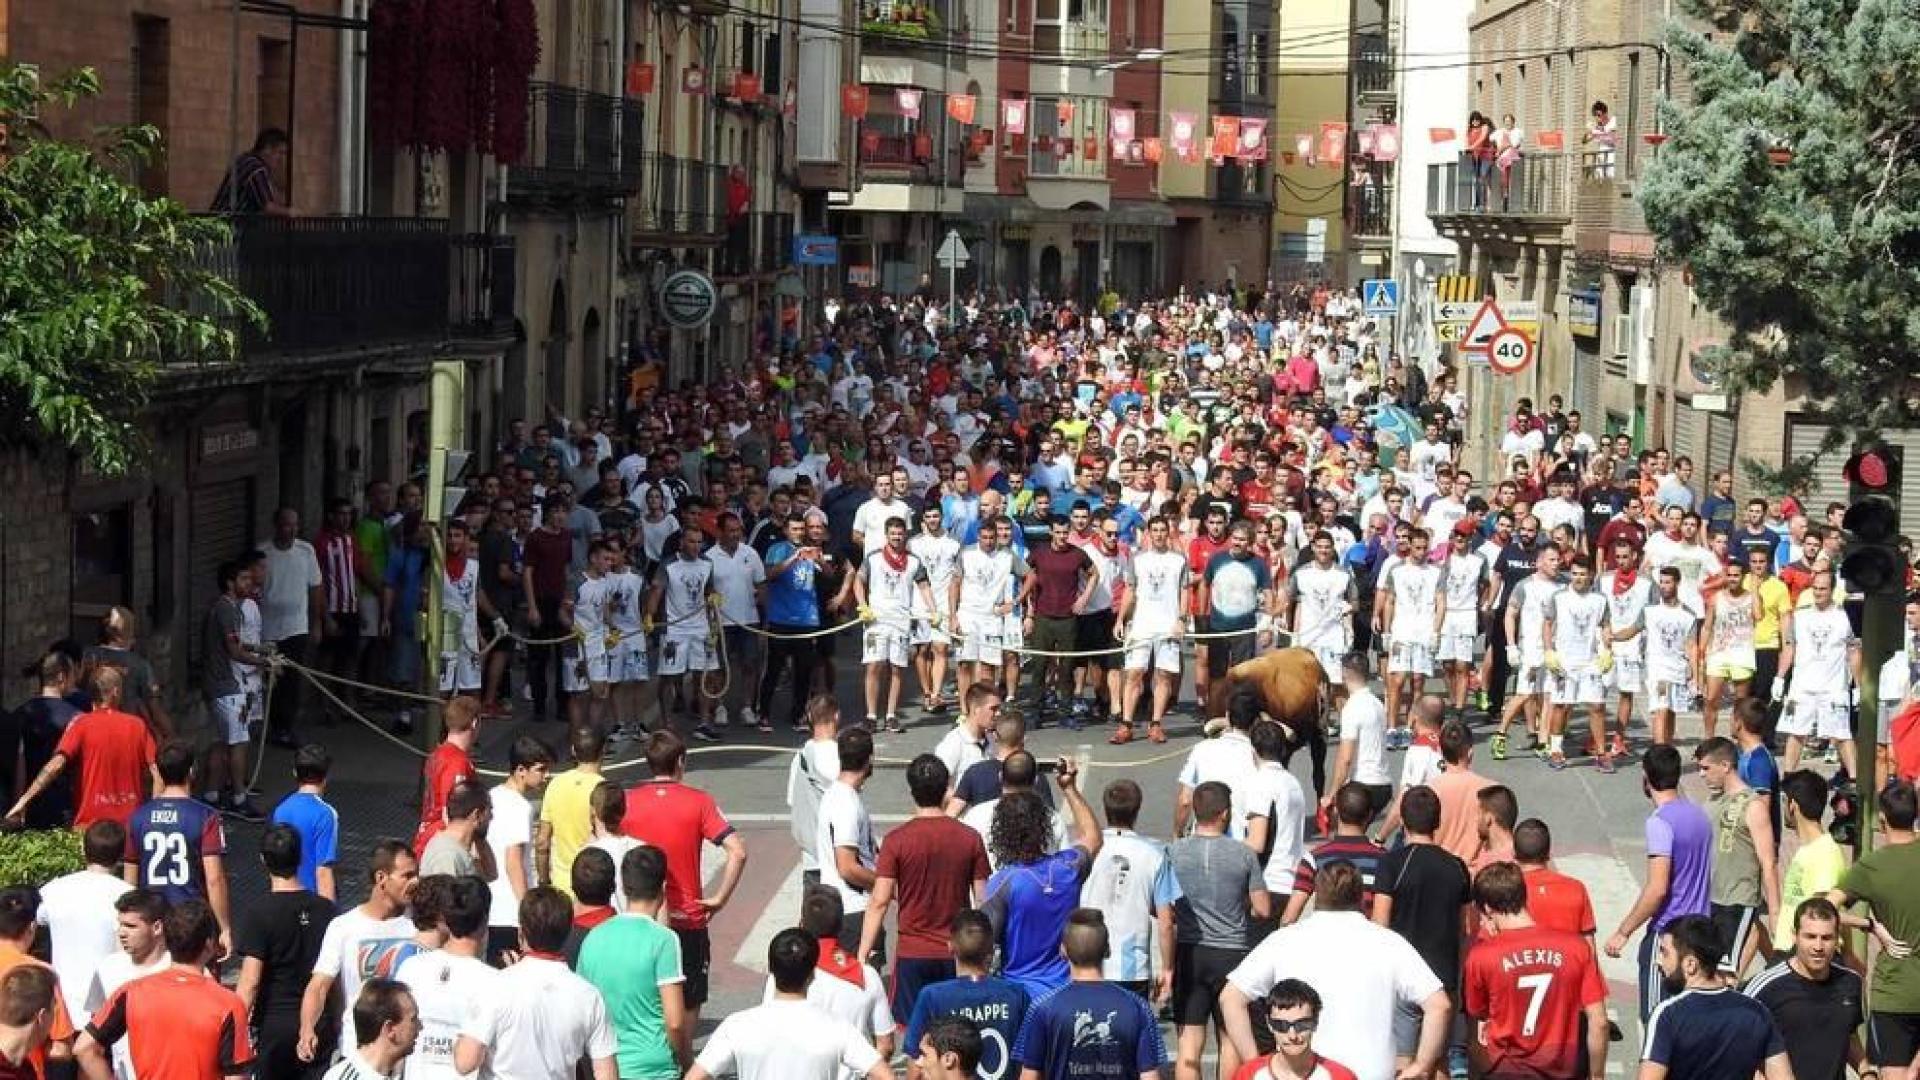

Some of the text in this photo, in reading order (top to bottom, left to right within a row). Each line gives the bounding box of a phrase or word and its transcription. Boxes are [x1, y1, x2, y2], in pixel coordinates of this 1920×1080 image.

[1496, 342, 1524, 358] 40
[143, 831, 189, 885] 23
[1502, 949, 1563, 973] ALEXIS
[951, 1003, 1009, 1023] BAPPE
[1517, 972, 1554, 1037] 7
